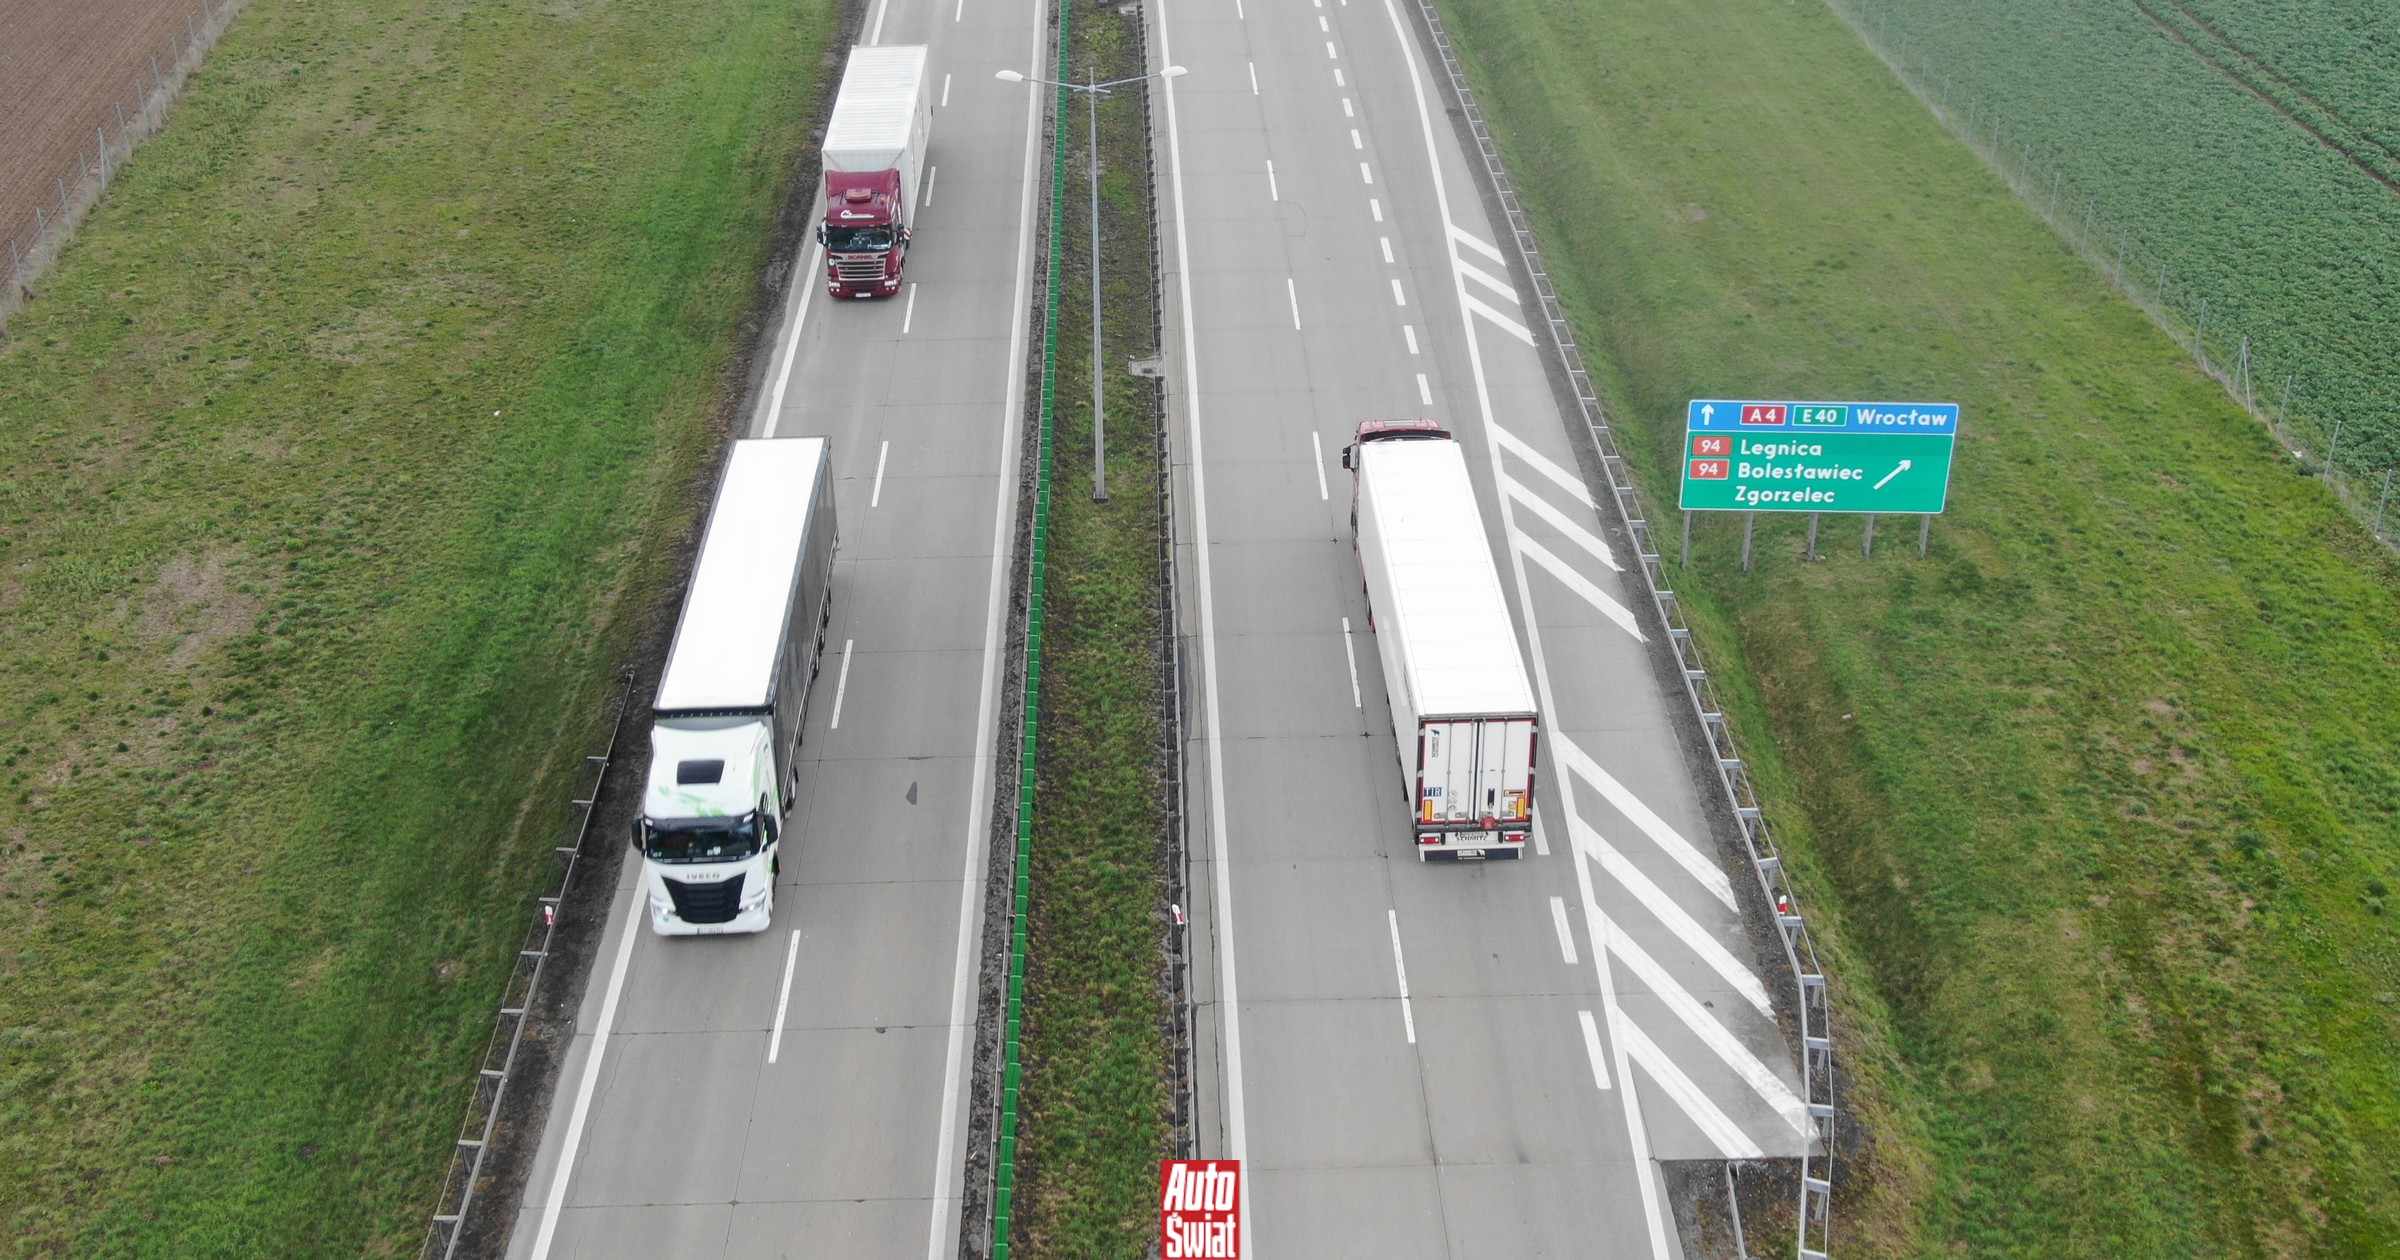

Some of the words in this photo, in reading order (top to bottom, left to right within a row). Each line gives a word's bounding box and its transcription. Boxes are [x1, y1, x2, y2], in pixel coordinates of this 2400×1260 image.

[1856, 409, 1948, 426] Wrocław
[1701, 440, 1721, 452] 94
[1740, 439, 1823, 459] Legnica
[1699, 463, 1719, 475] 94
[1738, 463, 1863, 480] Bolesławiec
[1735, 486, 1835, 505] Zgorzelec
[1424, 787, 1441, 796] TIR
[686, 872, 720, 880] IVECO
